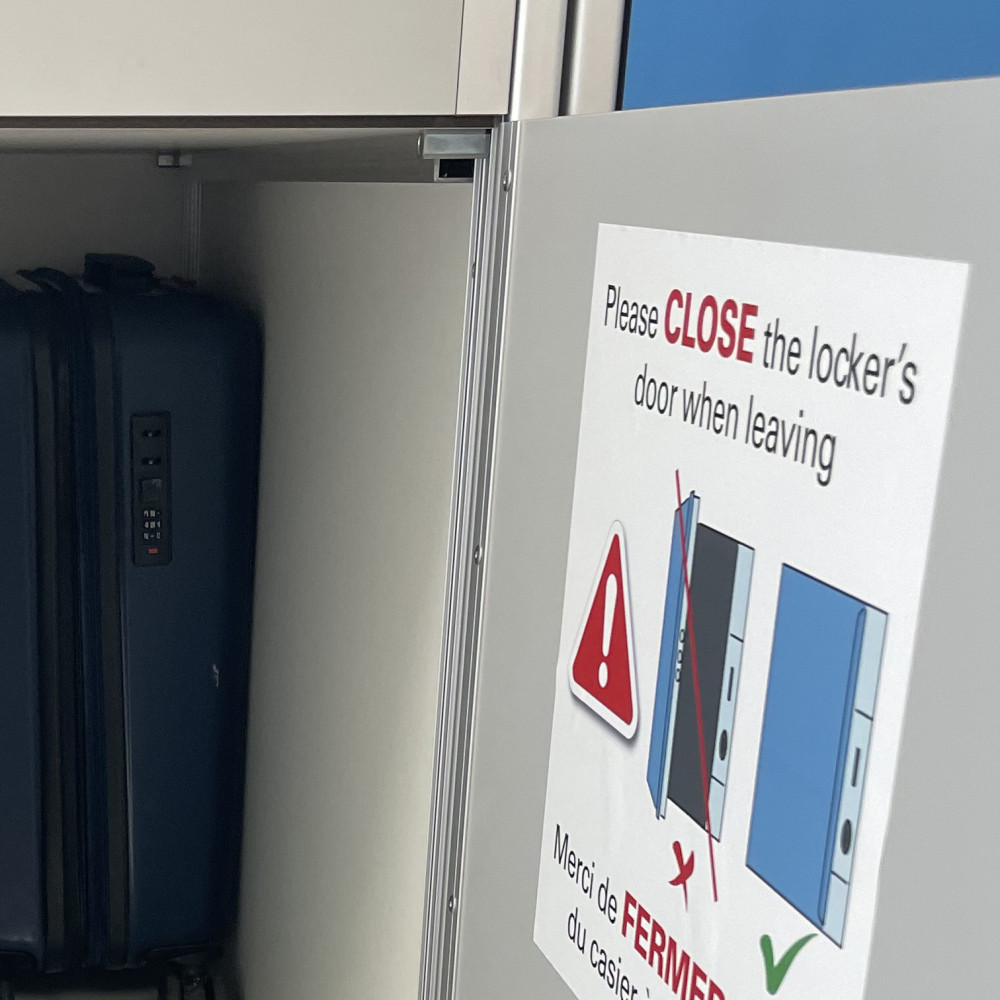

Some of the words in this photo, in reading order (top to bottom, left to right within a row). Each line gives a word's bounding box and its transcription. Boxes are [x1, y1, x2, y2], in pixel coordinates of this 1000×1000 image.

[604, 284, 659, 339] Please
[664, 288, 759, 364] CLOSE
[762, 317, 802, 376] the
[808, 325, 918, 405] locker's
[634, 363, 679, 417] door
[682, 381, 739, 440] when
[744, 394, 837, 487] leaving
[553, 823, 596, 899] Merci
[597, 876, 618, 924] de
[567, 907, 587, 955] du
